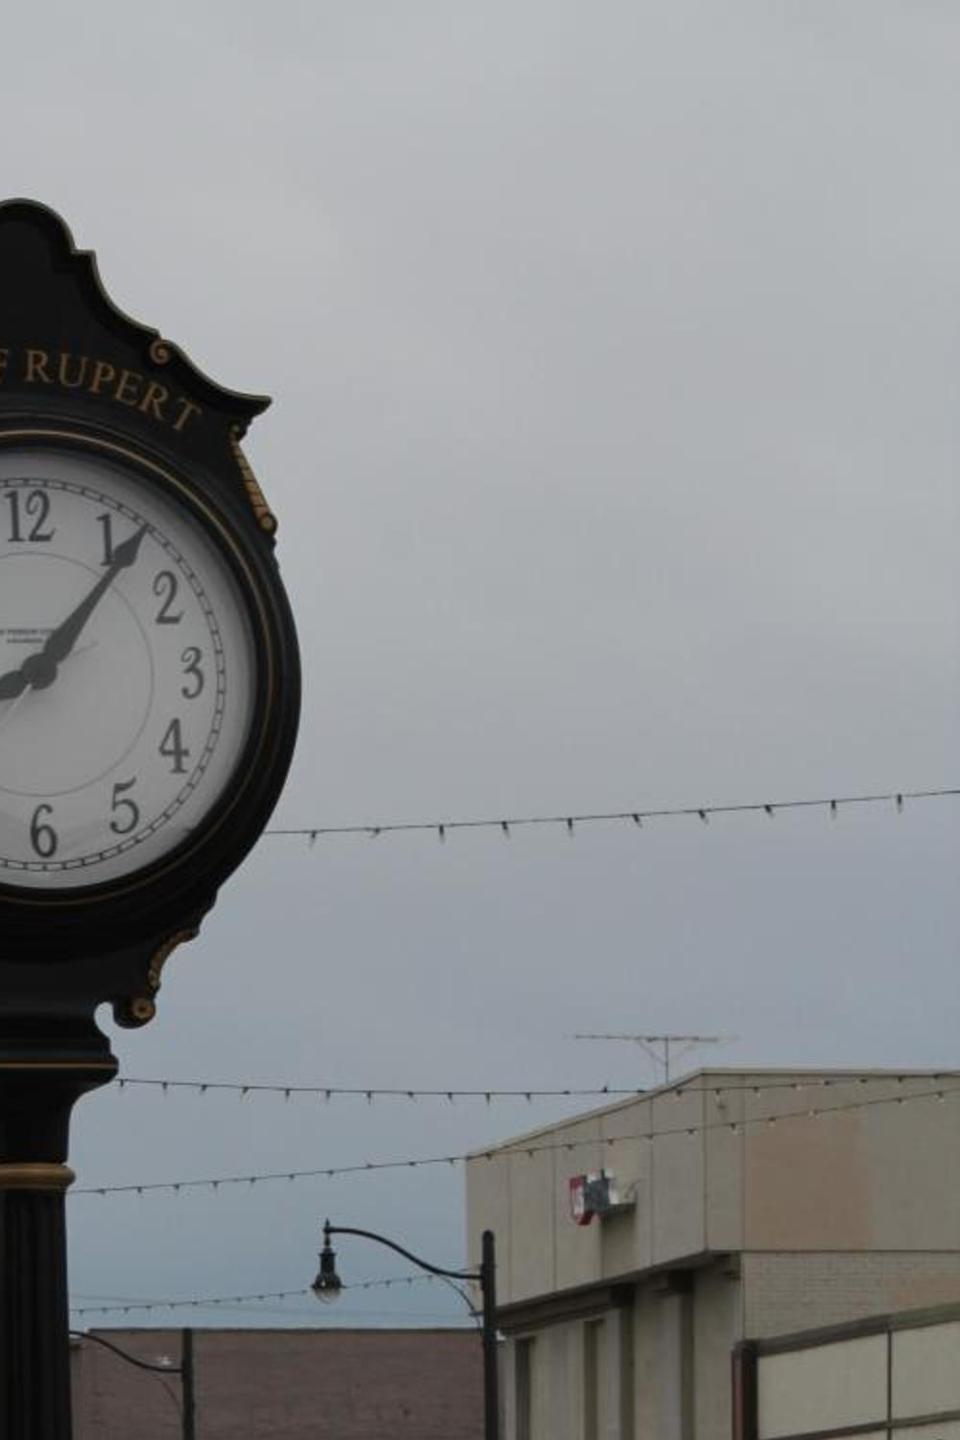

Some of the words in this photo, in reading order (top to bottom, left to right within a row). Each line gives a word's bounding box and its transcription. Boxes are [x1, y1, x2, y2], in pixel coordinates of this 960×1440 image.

[24, 349, 203, 432] RUPERT
[4, 489, 55, 542] 12
[96, 513, 117, 567] 1
[153, 570, 183, 625] 2
[181, 647, 205, 700] 3
[158, 717, 191, 775] 4
[29, 803, 59, 859] 6
[109, 777, 140, 834] 5
